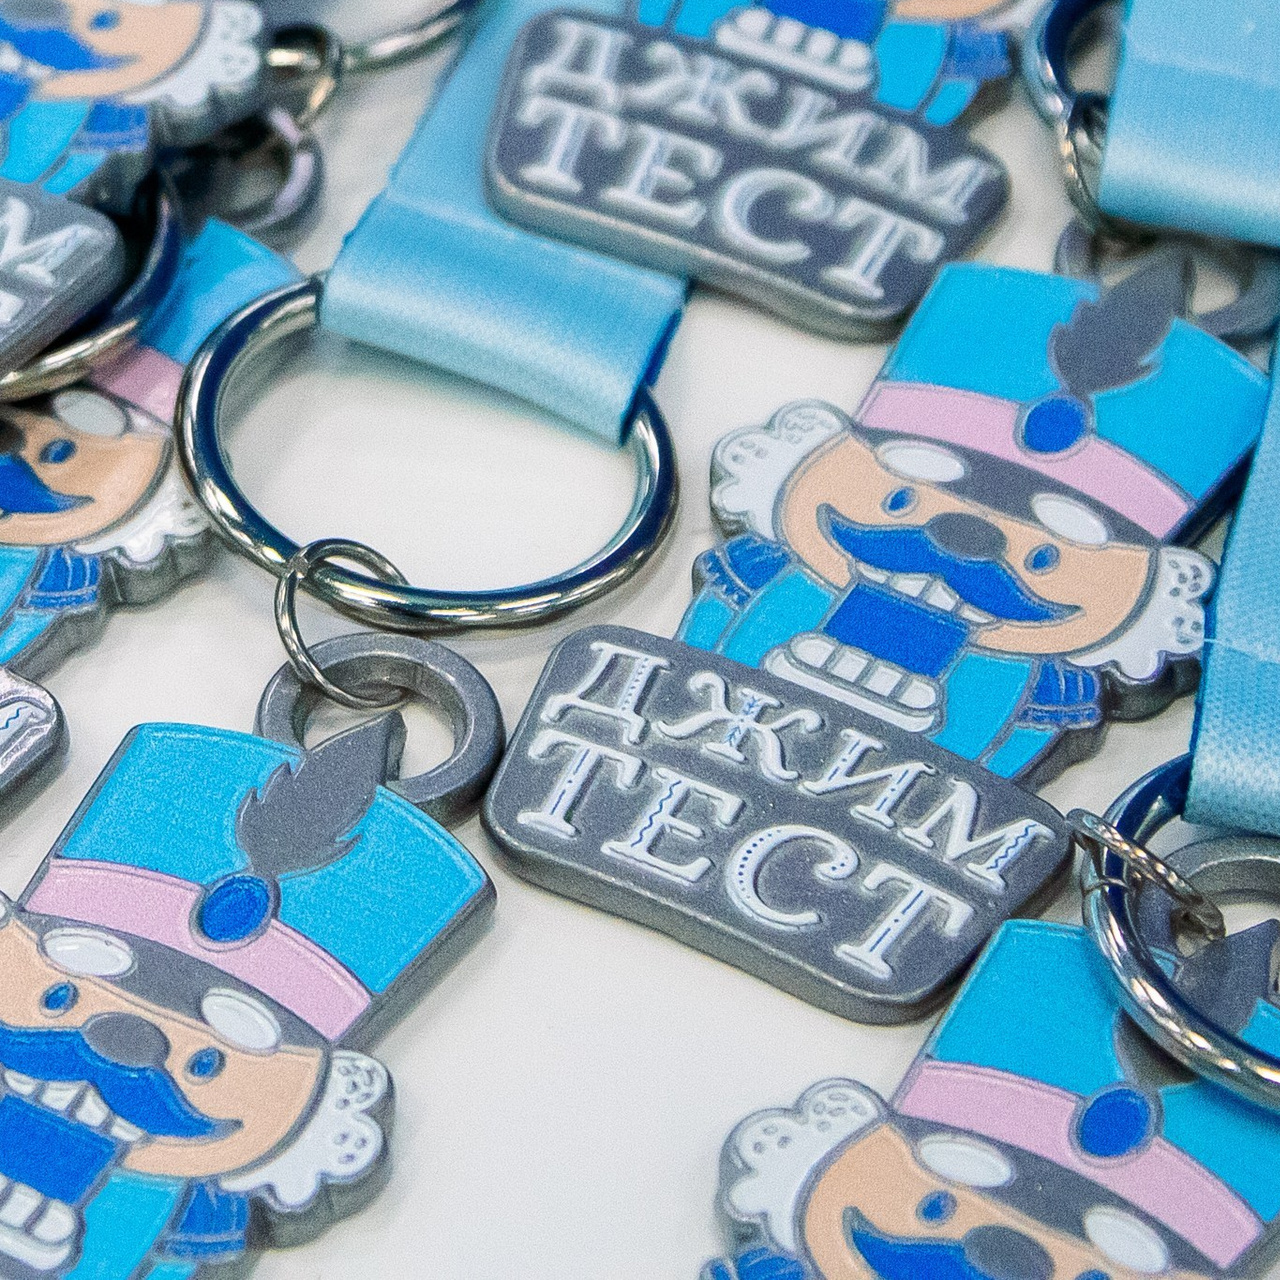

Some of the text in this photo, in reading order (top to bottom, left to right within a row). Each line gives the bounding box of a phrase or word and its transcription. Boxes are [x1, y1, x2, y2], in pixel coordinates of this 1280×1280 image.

[518, 95, 946, 299] ТЕСТ
[526, 20, 1000, 223] ДЖИМ
[517, 728, 975, 980] ТЕСТ
[544, 641, 1056, 893] ДЖИМ
